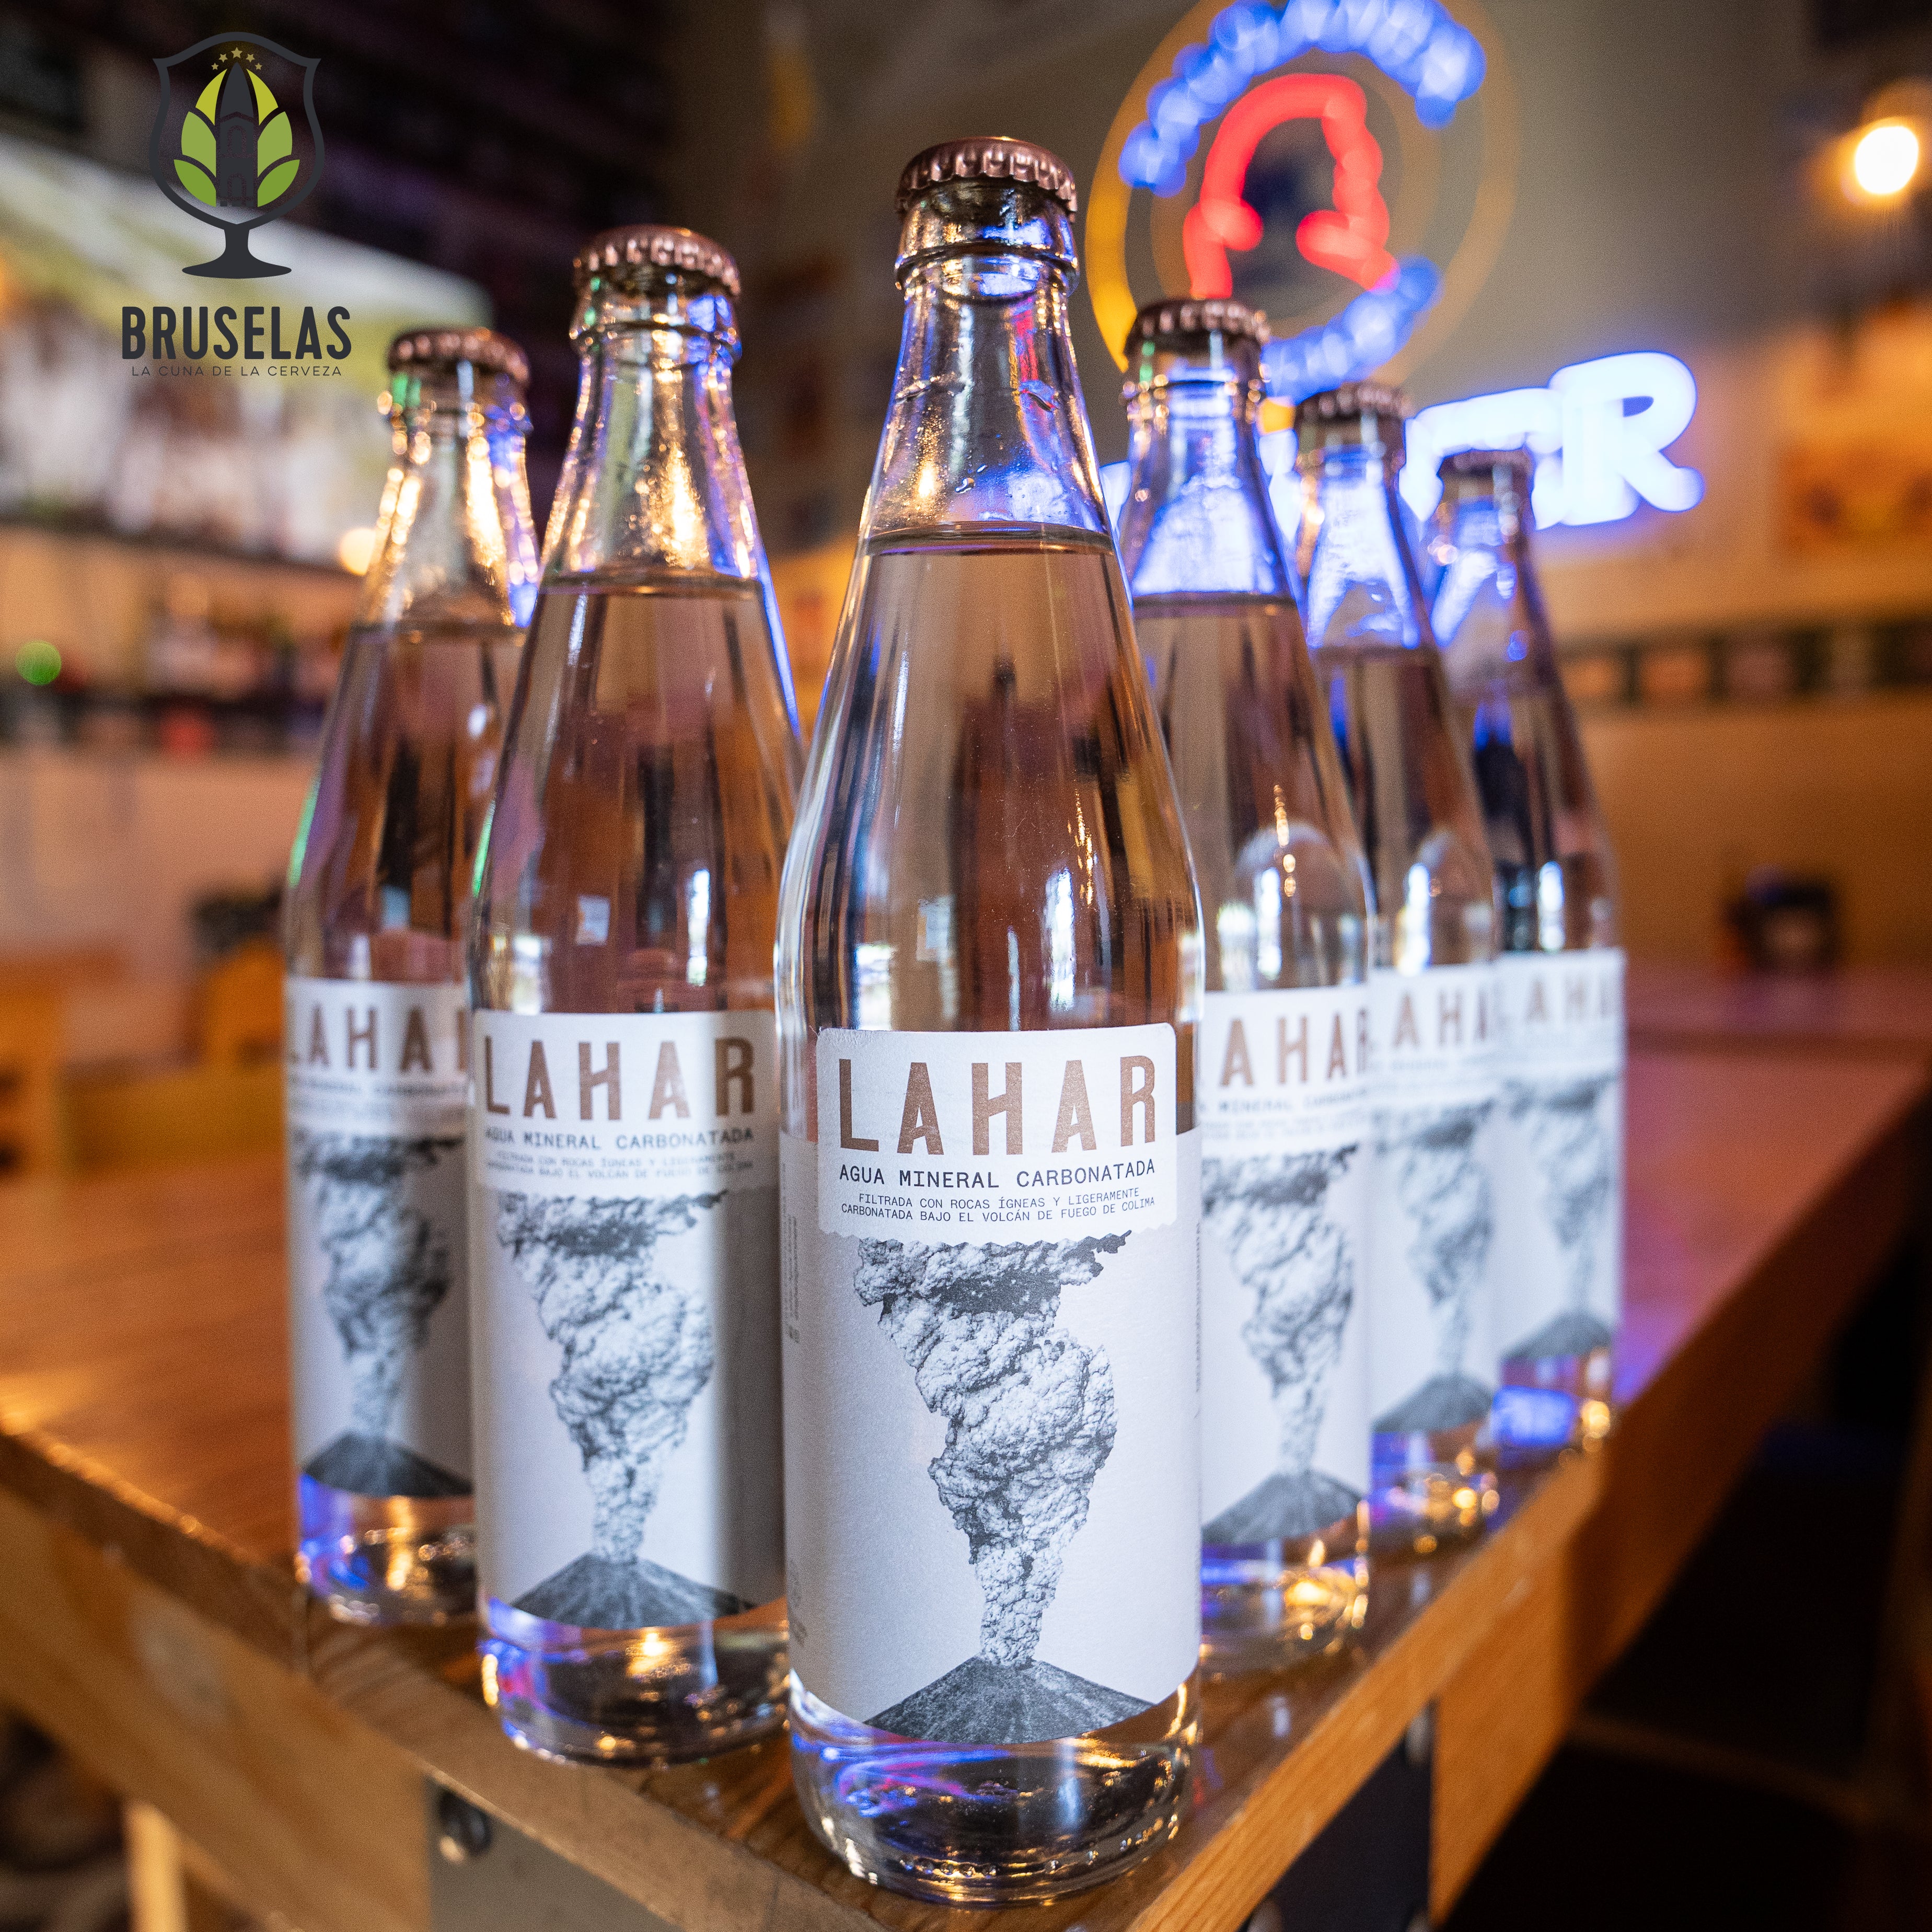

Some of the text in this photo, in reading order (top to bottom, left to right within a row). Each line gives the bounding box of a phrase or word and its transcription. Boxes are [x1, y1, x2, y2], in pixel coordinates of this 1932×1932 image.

[485, 1036, 755, 1121] LAHAR
[838, 1055, 1155, 1156] LAHAR
[524, 1130, 600, 1149] MINERAL
[616, 1127, 754, 1150] CARBONATADA
[839, 1158, 1155, 1189] AGUA MINERAL CARBONATADA
[841, 1196, 1155, 1222] CARBONATADA BAJO EL VOLCÁN DE FUEGO DE COLIMA
[859, 1187, 1139, 1210] FILTRADA CON ROCAS ÍGNEAS Y LIGERAMENTE
